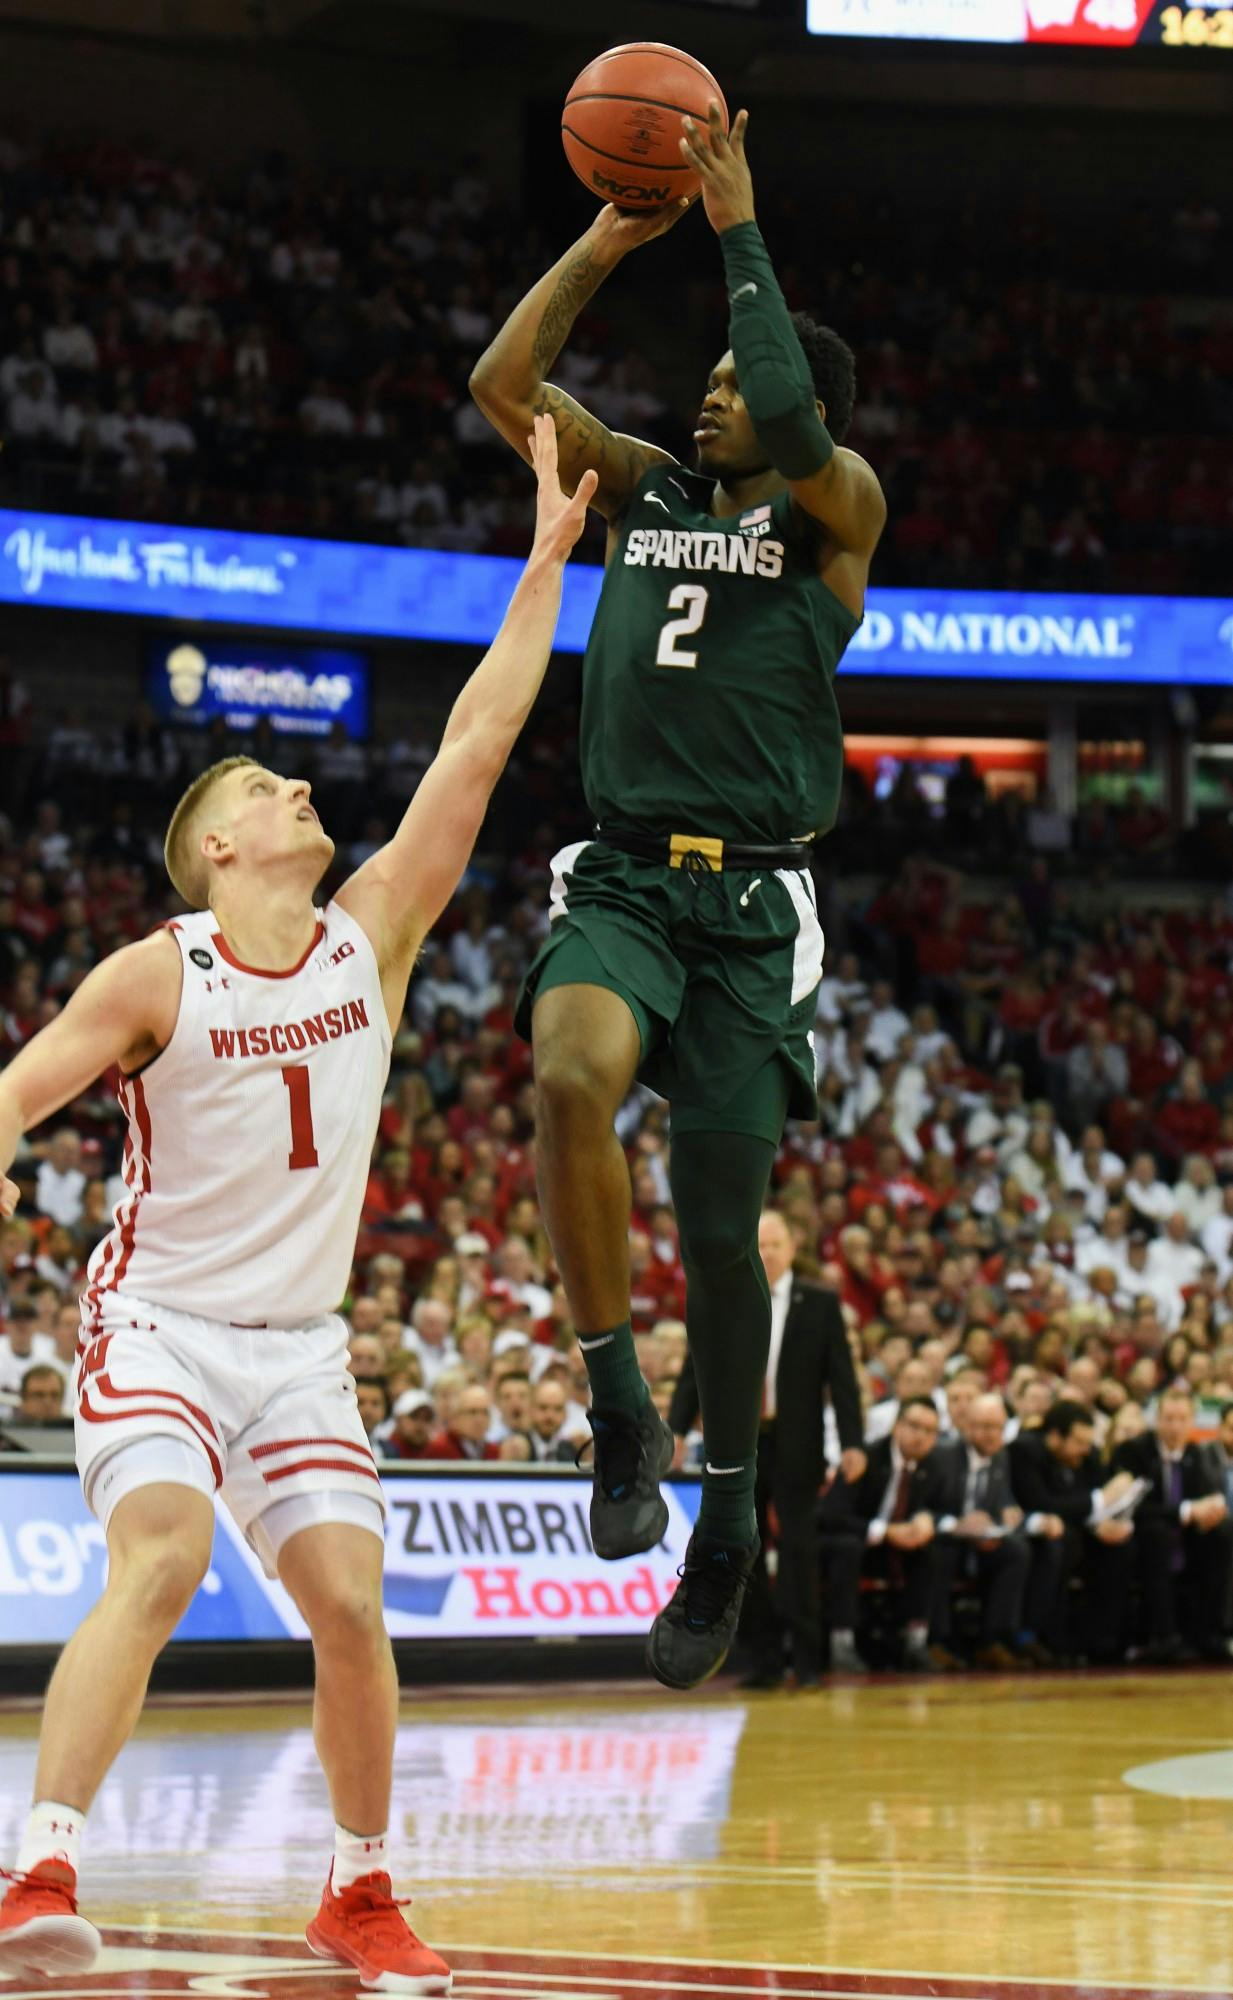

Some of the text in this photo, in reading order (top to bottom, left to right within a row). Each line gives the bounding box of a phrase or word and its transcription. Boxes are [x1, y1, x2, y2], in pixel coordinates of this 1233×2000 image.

[592, 169, 671, 200] NCAA
[624, 529, 785, 579] SPARTANS
[656, 584, 709, 669] 2
[903, 612, 1133, 658] NATIONAL
[209, 998, 370, 1059] WISCONSIN
[281, 1065, 319, 1170] 1
[392, 1500, 673, 1554] ZIMBRI
[461, 1562, 681, 1619] Hond
